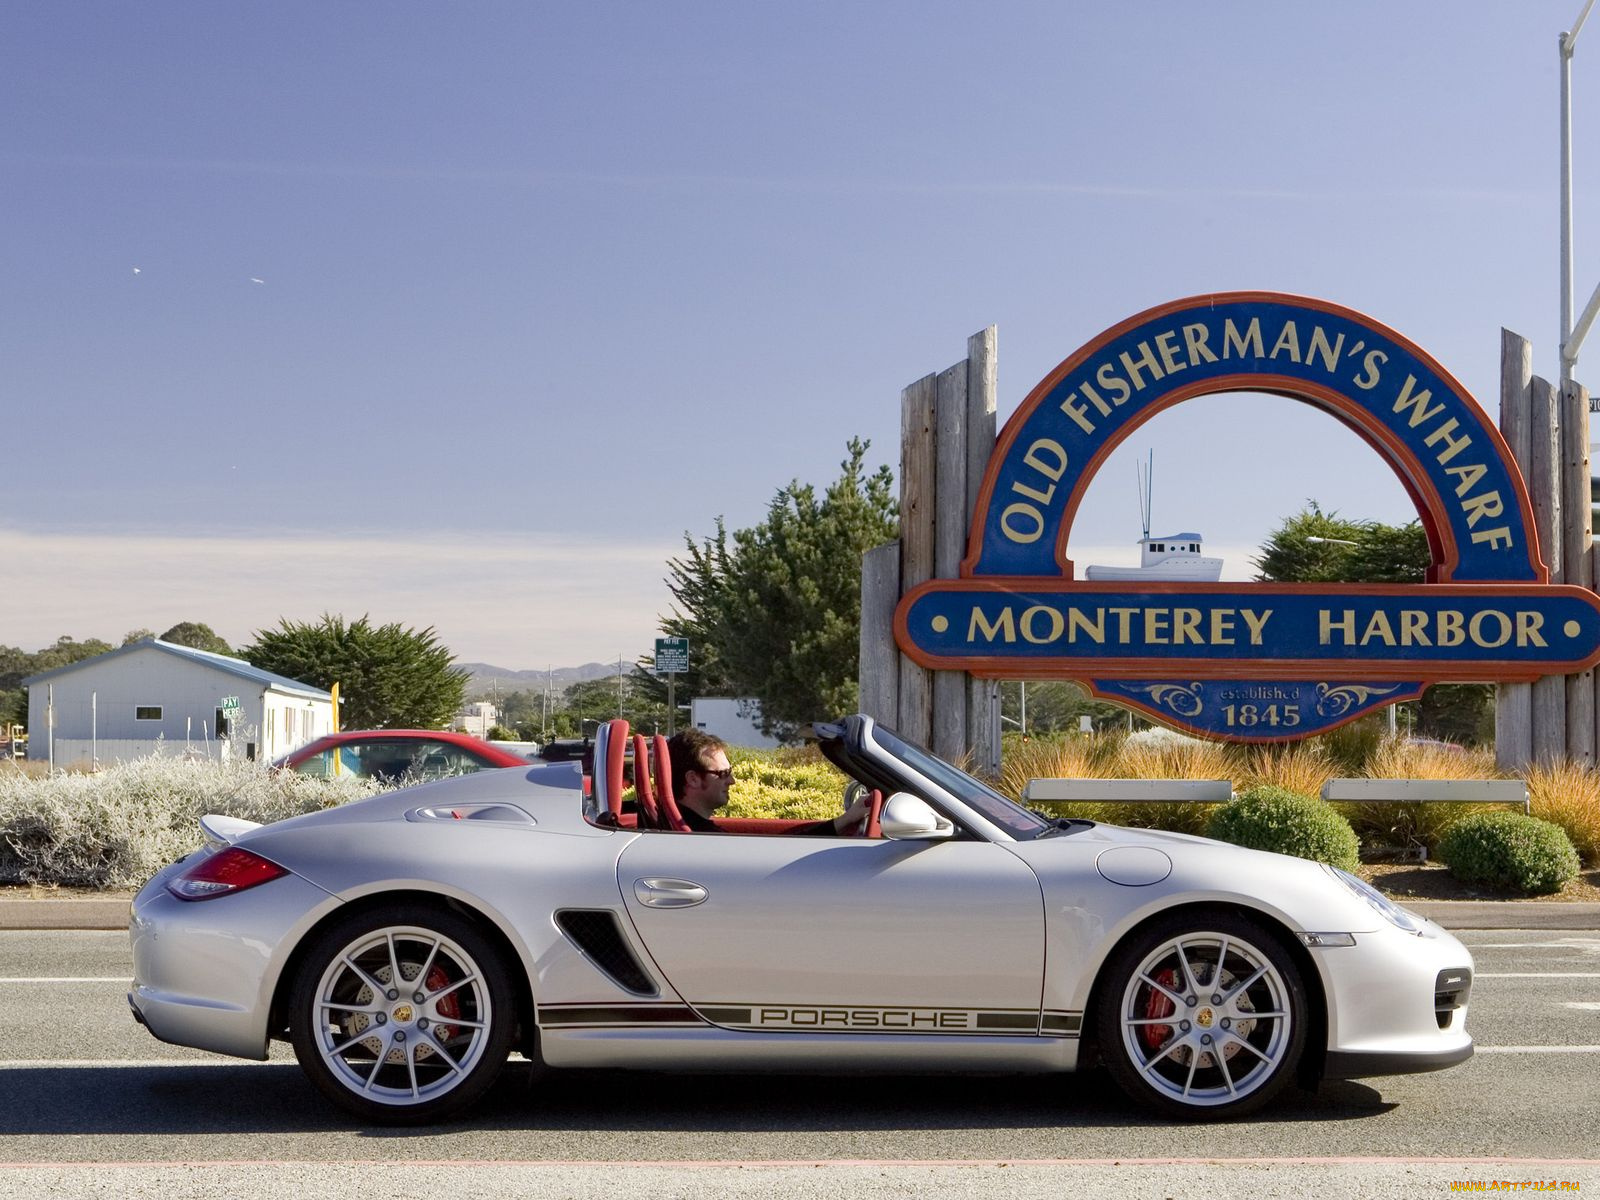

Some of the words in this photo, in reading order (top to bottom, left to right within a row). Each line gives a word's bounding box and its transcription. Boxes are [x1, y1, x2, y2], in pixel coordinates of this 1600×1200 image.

[1001, 438, 1068, 544] OLD
[1061, 318, 1389, 434] FISHERMAN'S
[1393, 374, 1513, 551] WHARF
[967, 606, 1273, 646] MONTEREY
[1319, 610, 1547, 648] HARBOR
[223, 697, 238, 708] PAY
[1219, 686, 1300, 700] established
[223, 708, 240, 718] HERE
[1221, 703, 1301, 727] 1845
[760, 1008, 968, 1028] PORSCHE
